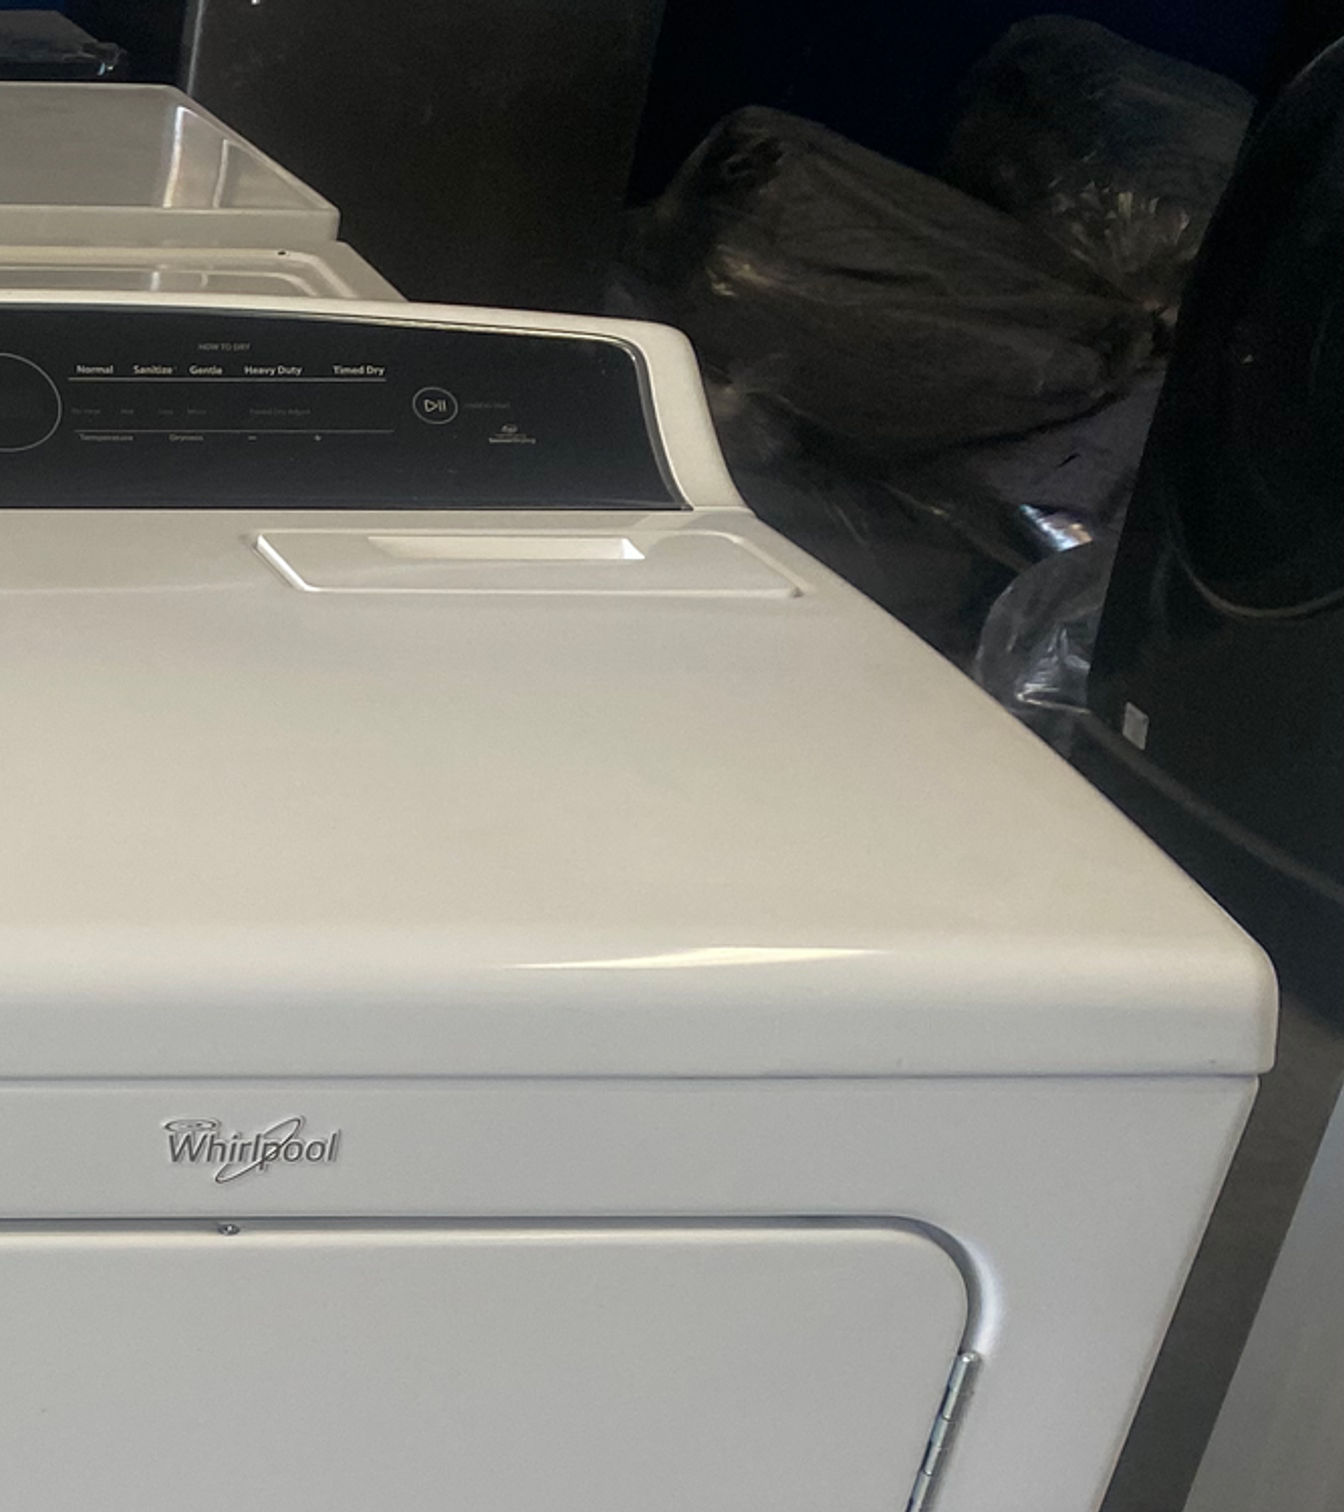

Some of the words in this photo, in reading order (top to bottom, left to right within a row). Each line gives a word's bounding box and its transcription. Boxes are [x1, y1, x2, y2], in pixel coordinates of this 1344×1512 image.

[76, 364, 114, 374] Normal
[189, 365, 223, 375] Gentle
[244, 365, 276, 377] Heavy
[277, 365, 303, 377] Duty
[333, 365, 365, 375] Timed
[367, 365, 385, 377] Dry
[166, 1122, 342, 1179] Whirlpool
